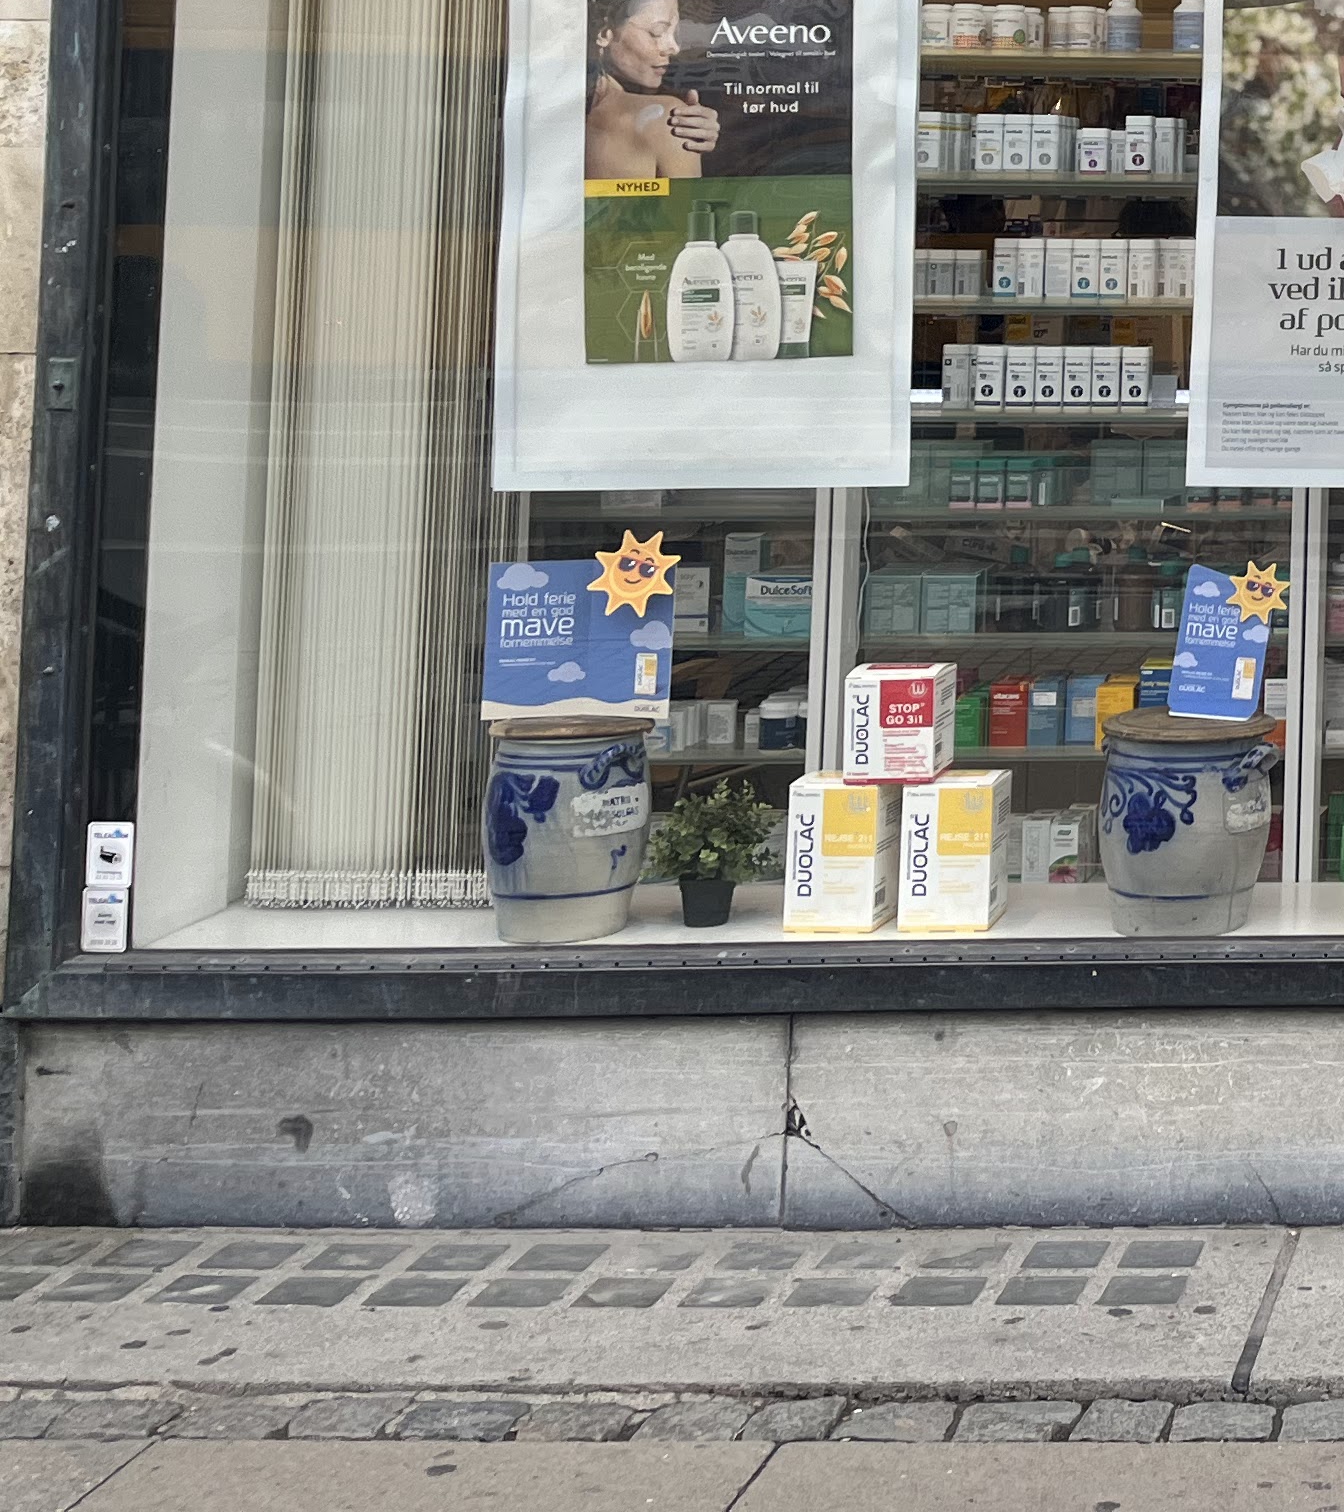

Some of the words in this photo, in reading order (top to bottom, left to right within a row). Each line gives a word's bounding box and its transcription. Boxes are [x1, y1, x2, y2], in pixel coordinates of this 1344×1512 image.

[710, 17, 832, 44] Aveeno
[724, 82, 741, 95] Til
[746, 82, 800, 95] normal
[804, 82, 819, 94] til
[743, 102, 765, 114] tør
[770, 101, 799, 113] hud
[616, 182, 660, 192] NYHED
[1276, 249, 1290, 270] 1
[1297, 248, 1332, 272] ud
[1268, 277, 1319, 301] ved
[1279, 307, 1306, 331] af
[1290, 345, 1311, 357] Har
[1314, 345, 1328, 357] du
[1319, 361, 1332, 374] så
[502, 592, 539, 605] Hold
[544, 592, 576, 605] ferie
[502, 607, 527, 617] med
[531, 608, 547, 617] en
[551, 606, 574, 619] god
[1189, 603, 1214, 614] Hold
[1217, 604, 1240, 615] ferie
[501, 617, 575, 637] mave
[1185, 622, 1238, 639] mave
[500, 636, 573, 648] fornemmelse
[889, 704, 920, 713] STOP
[886, 715, 904, 724] GO
[855, 694, 869, 765] DUOLAC
[797, 815, 815, 897] DUOLAC
[912, 814, 929, 897] DUOLAC
